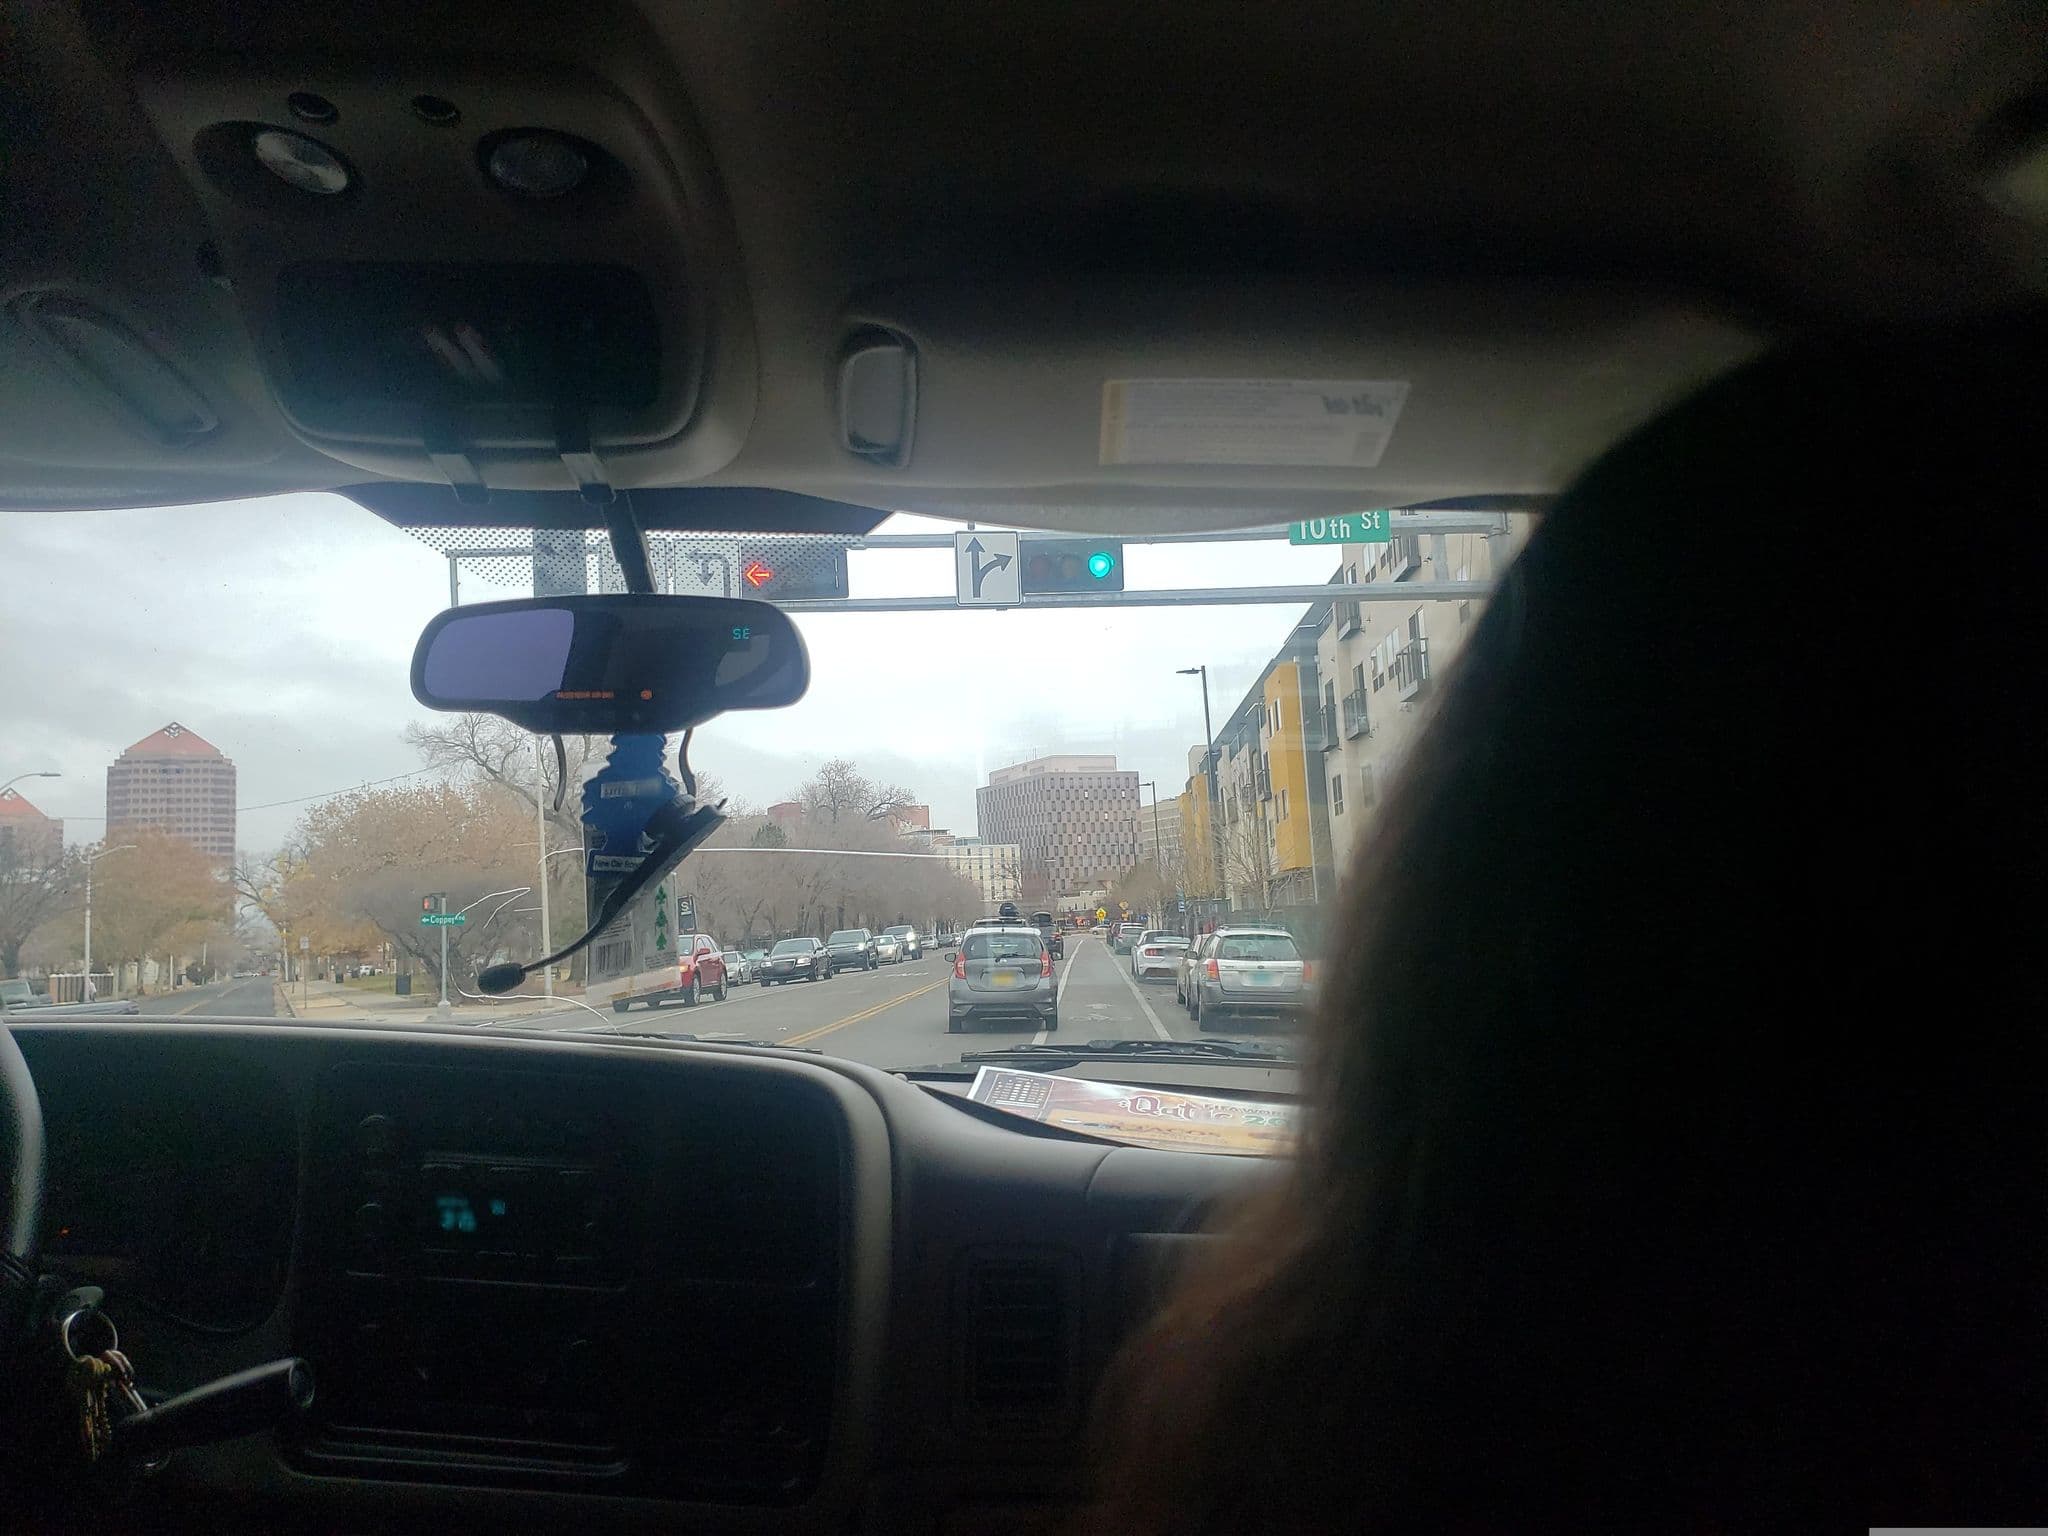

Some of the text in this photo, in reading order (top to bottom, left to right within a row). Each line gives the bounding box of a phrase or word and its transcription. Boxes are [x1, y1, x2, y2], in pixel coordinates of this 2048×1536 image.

[1300, 511, 1381, 540] 10th St
[732, 628, 751, 640] SE
[430, 915, 455, 925] Copper
